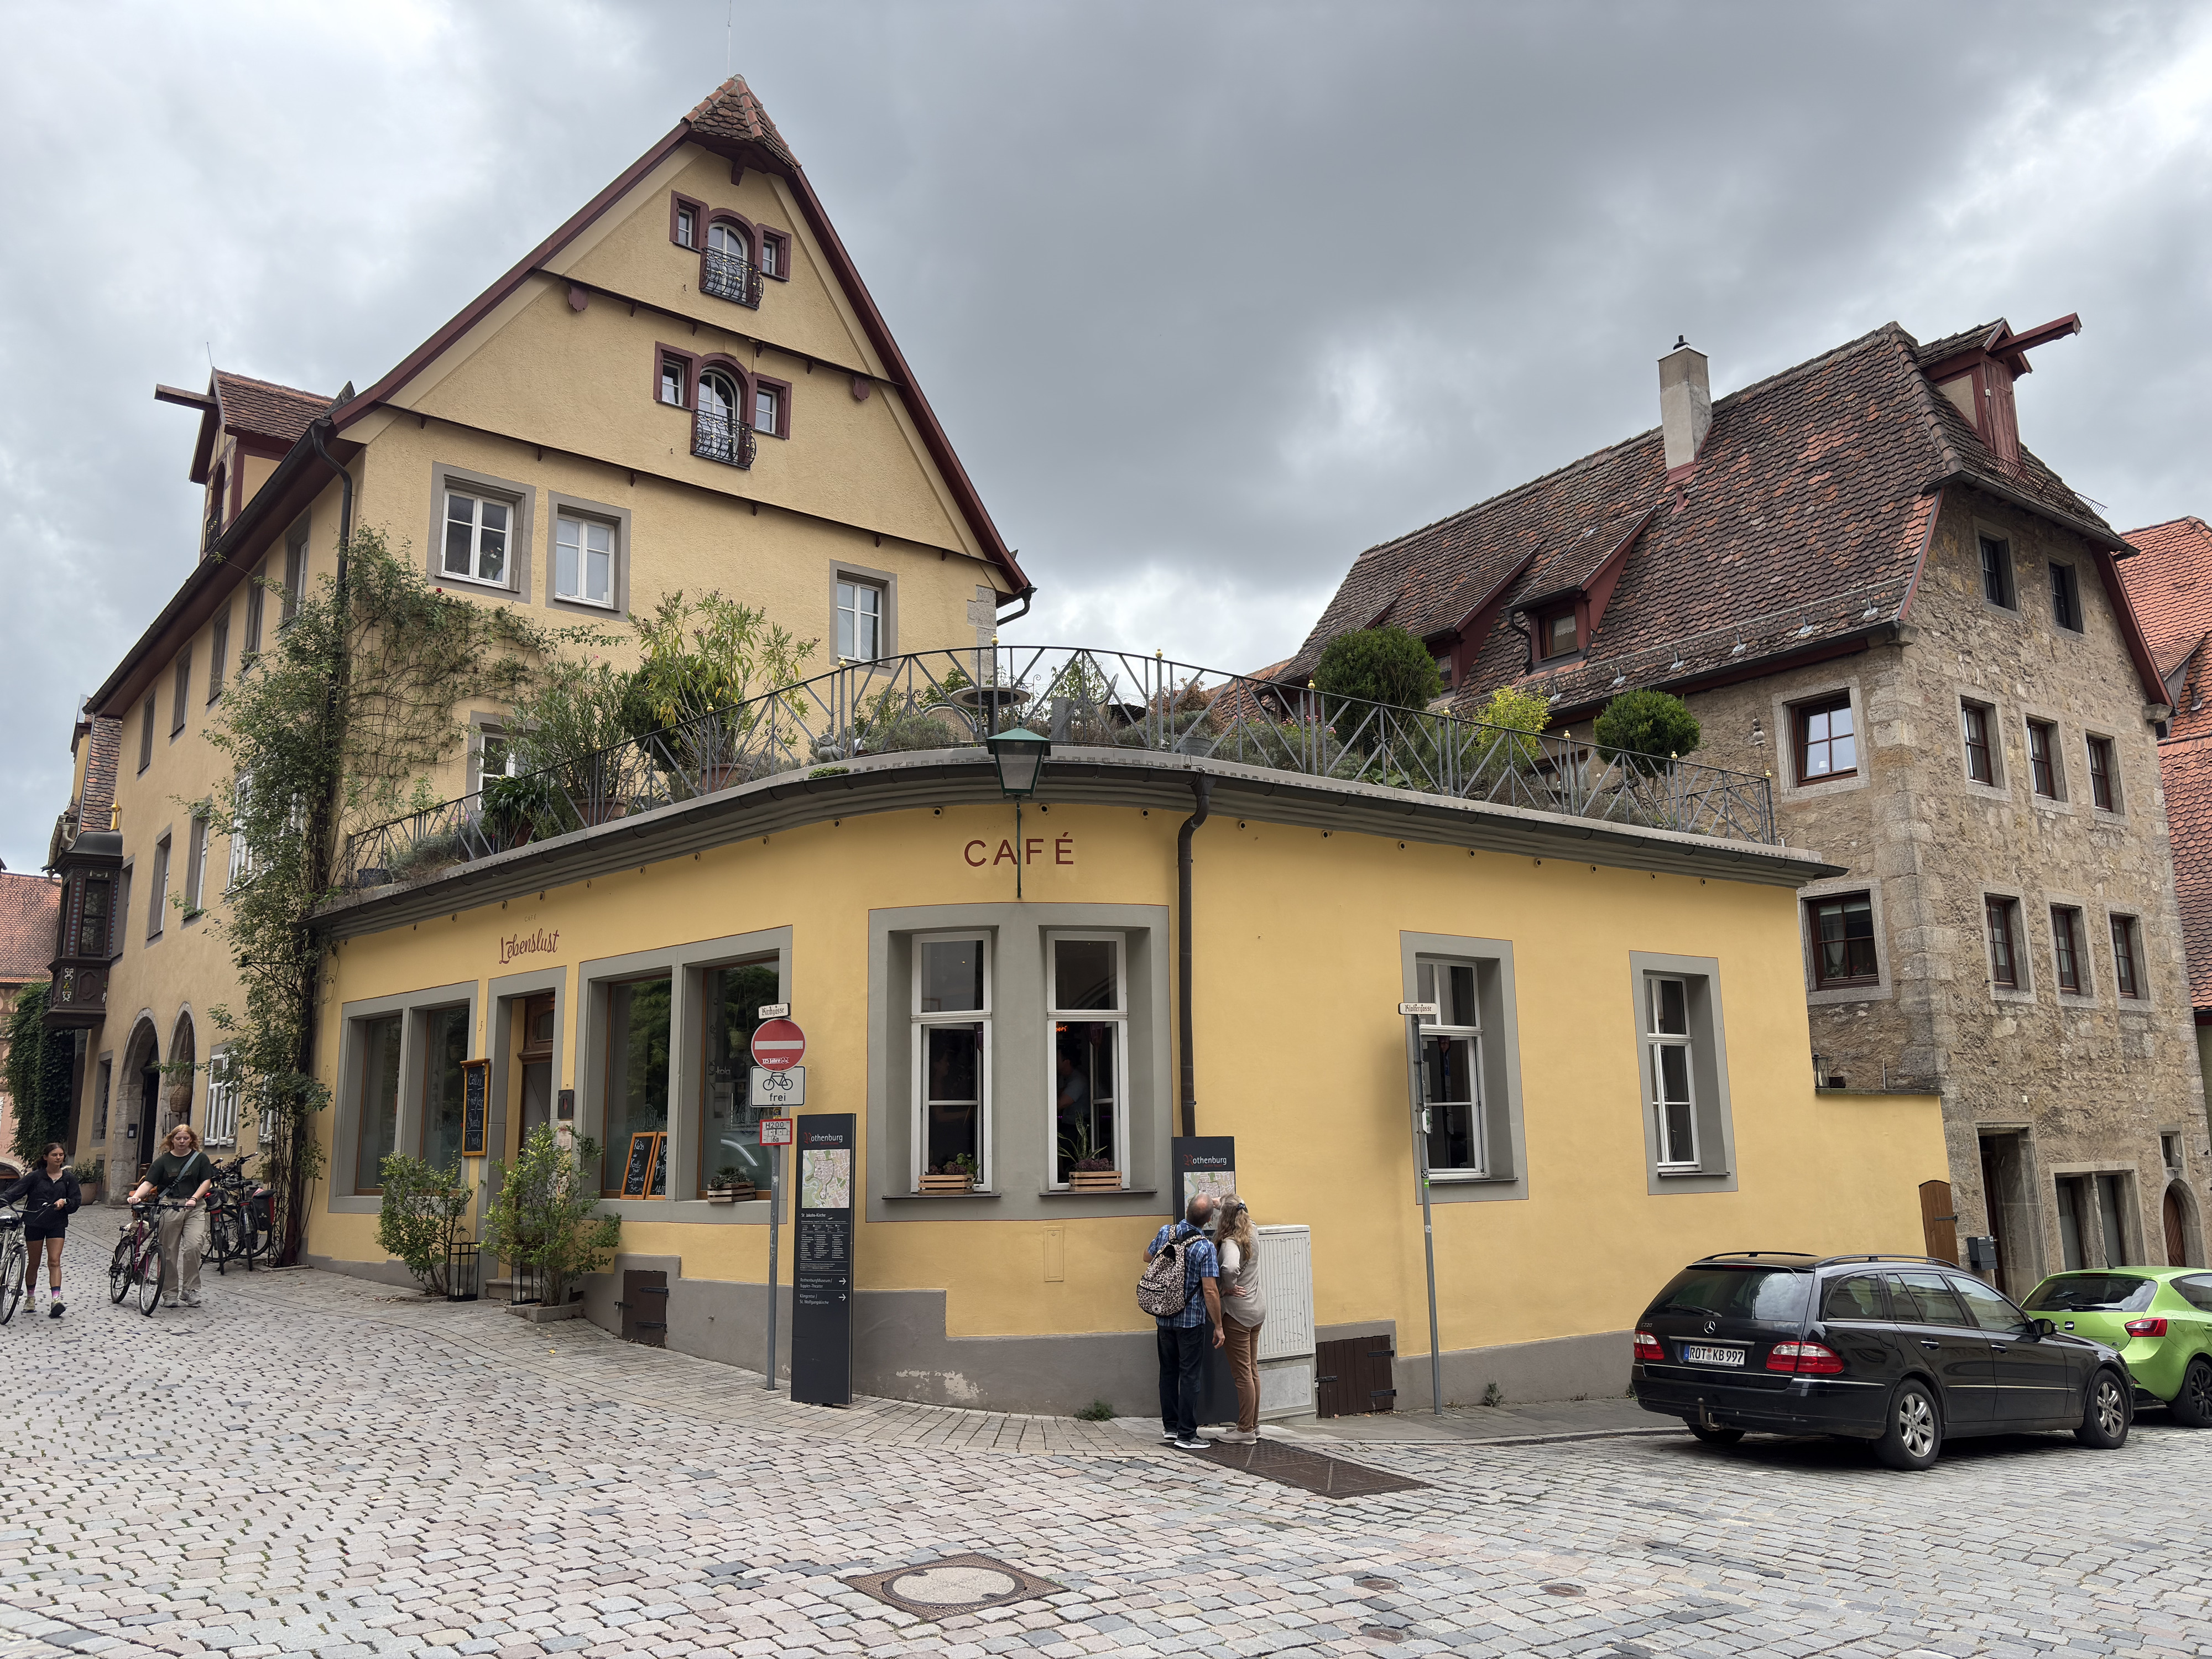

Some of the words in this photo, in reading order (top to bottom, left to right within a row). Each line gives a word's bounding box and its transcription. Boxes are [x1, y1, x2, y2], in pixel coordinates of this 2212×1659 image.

[964, 832, 1074, 867] CAFÉ
[499, 928, 559, 964] Lebenslust
[769, 1093, 786, 1102] frei
[804, 1133, 843, 1144] Rothenburg
[1183, 1154, 1227, 1166] Rothenburg
[1689, 1347, 1707, 1360] ROT
[1713, 1349, 1725, 1361] KB
[1726, 1350, 1744, 1363] 997
